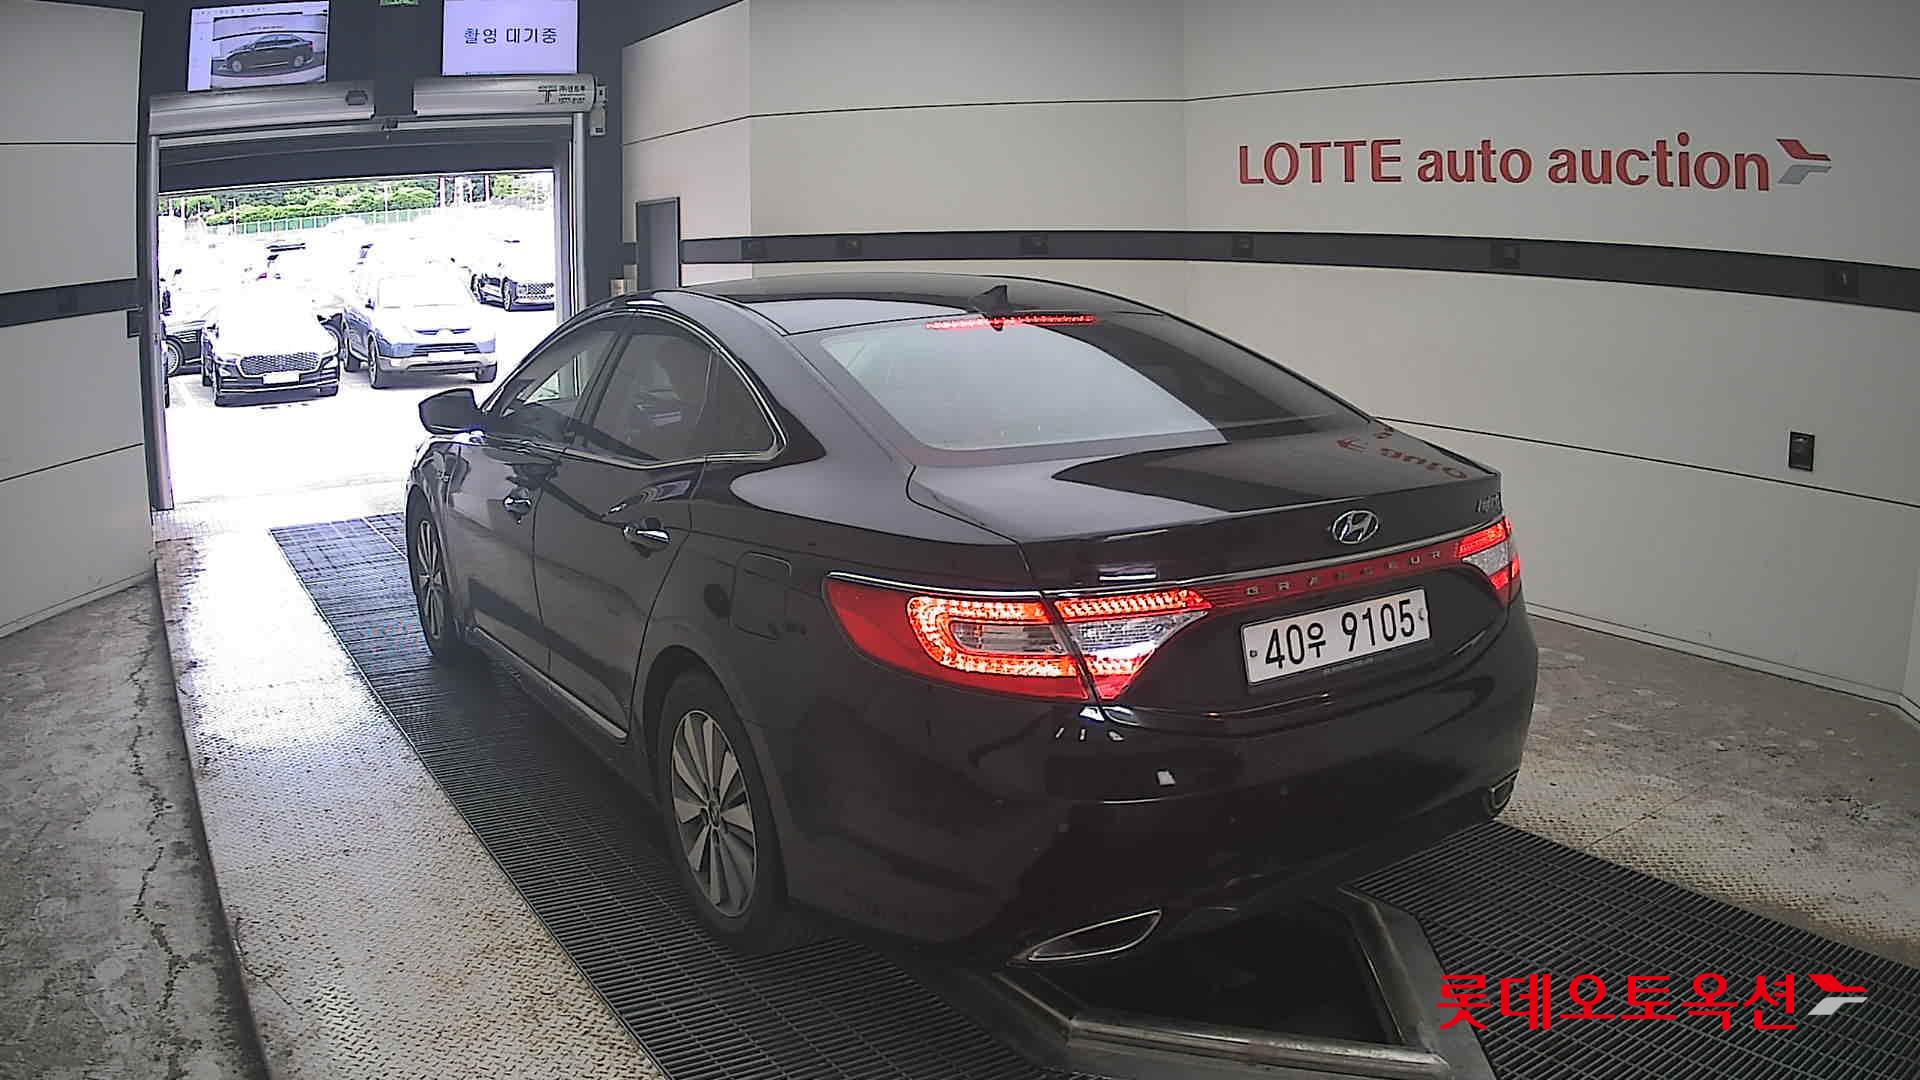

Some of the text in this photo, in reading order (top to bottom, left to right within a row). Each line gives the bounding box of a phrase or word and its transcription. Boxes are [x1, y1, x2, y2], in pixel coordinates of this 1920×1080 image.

[464, 28, 558, 44] 촬영 대기중
[1240, 132, 1769, 191] LOTTE auto auction
[1265, 599, 1415, 669] 40우 9105
